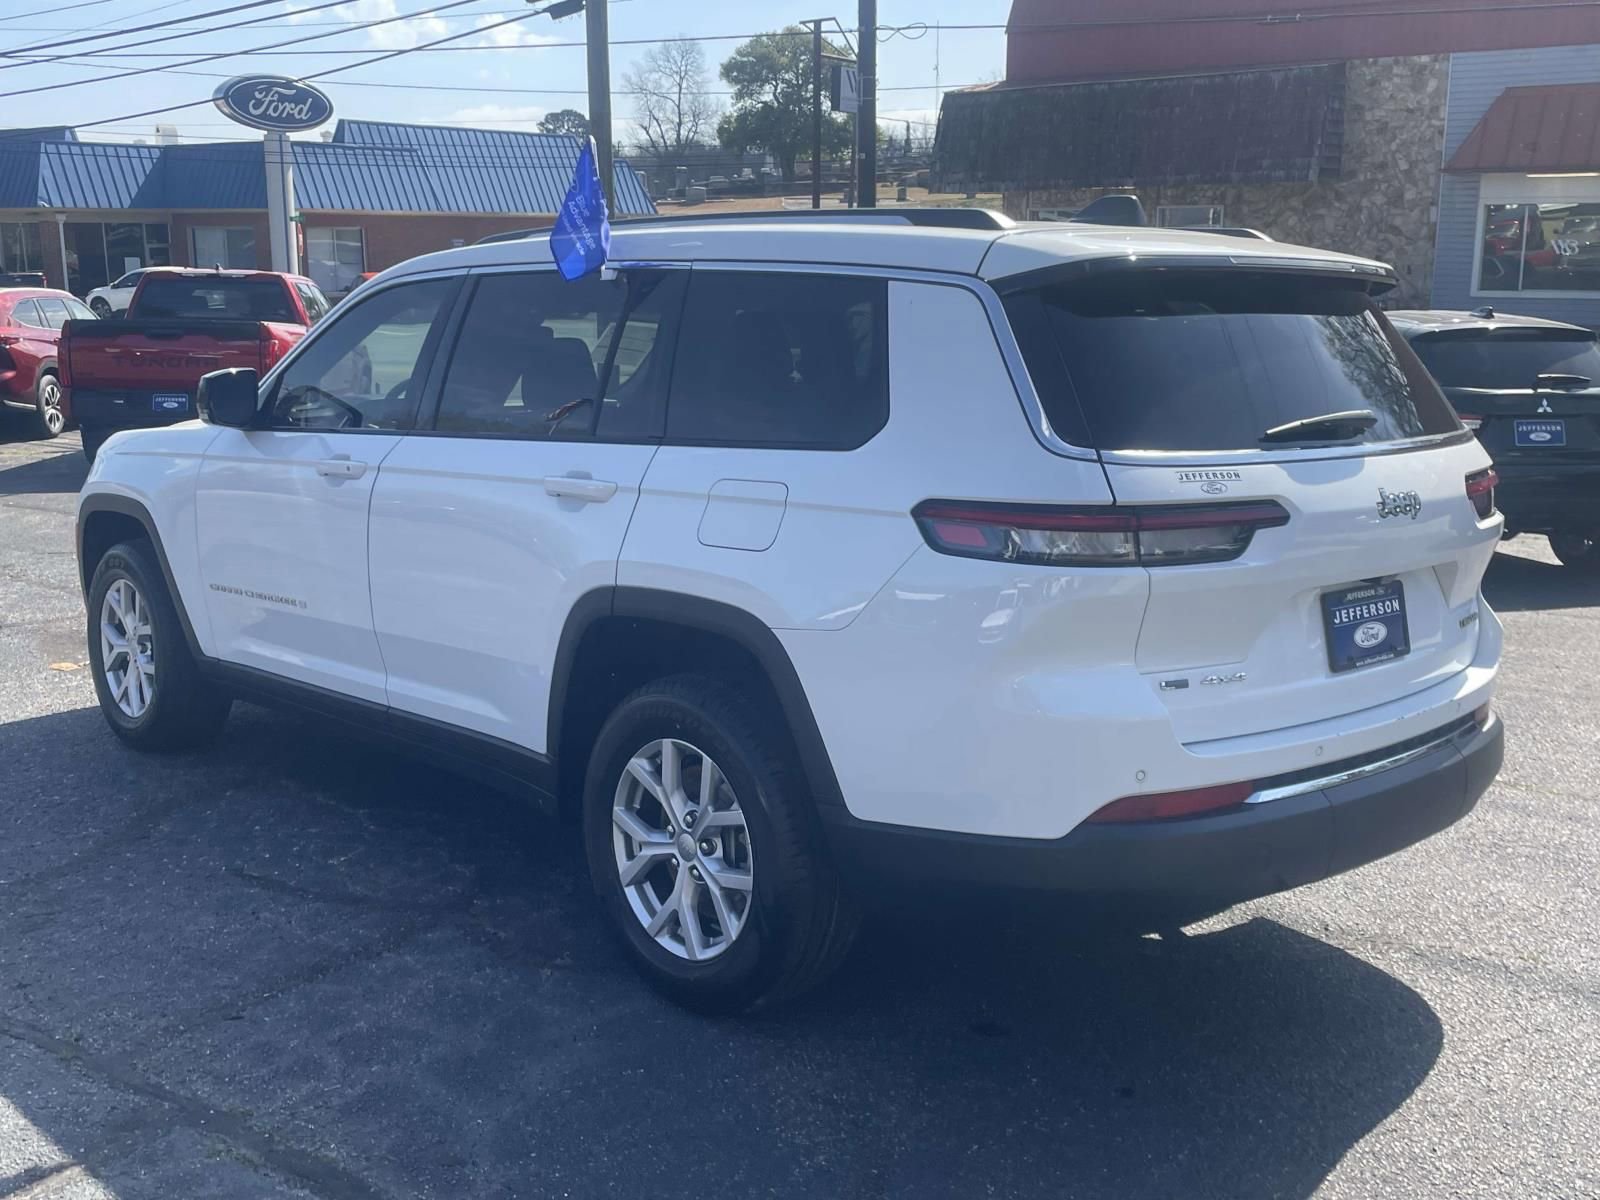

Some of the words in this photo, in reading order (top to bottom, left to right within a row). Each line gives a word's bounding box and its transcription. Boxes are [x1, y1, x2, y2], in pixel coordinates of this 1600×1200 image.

[248, 85, 314, 120] Ford
[575, 195, 590, 218] Blue
[567, 200, 596, 250] Advantage
[1518, 424, 1562, 432] JEFFERSON
[1178, 471, 1241, 481] JEFFERSON
[1376, 487, 1422, 520] Jeep
[1333, 599, 1400, 624] JEFFERSON
